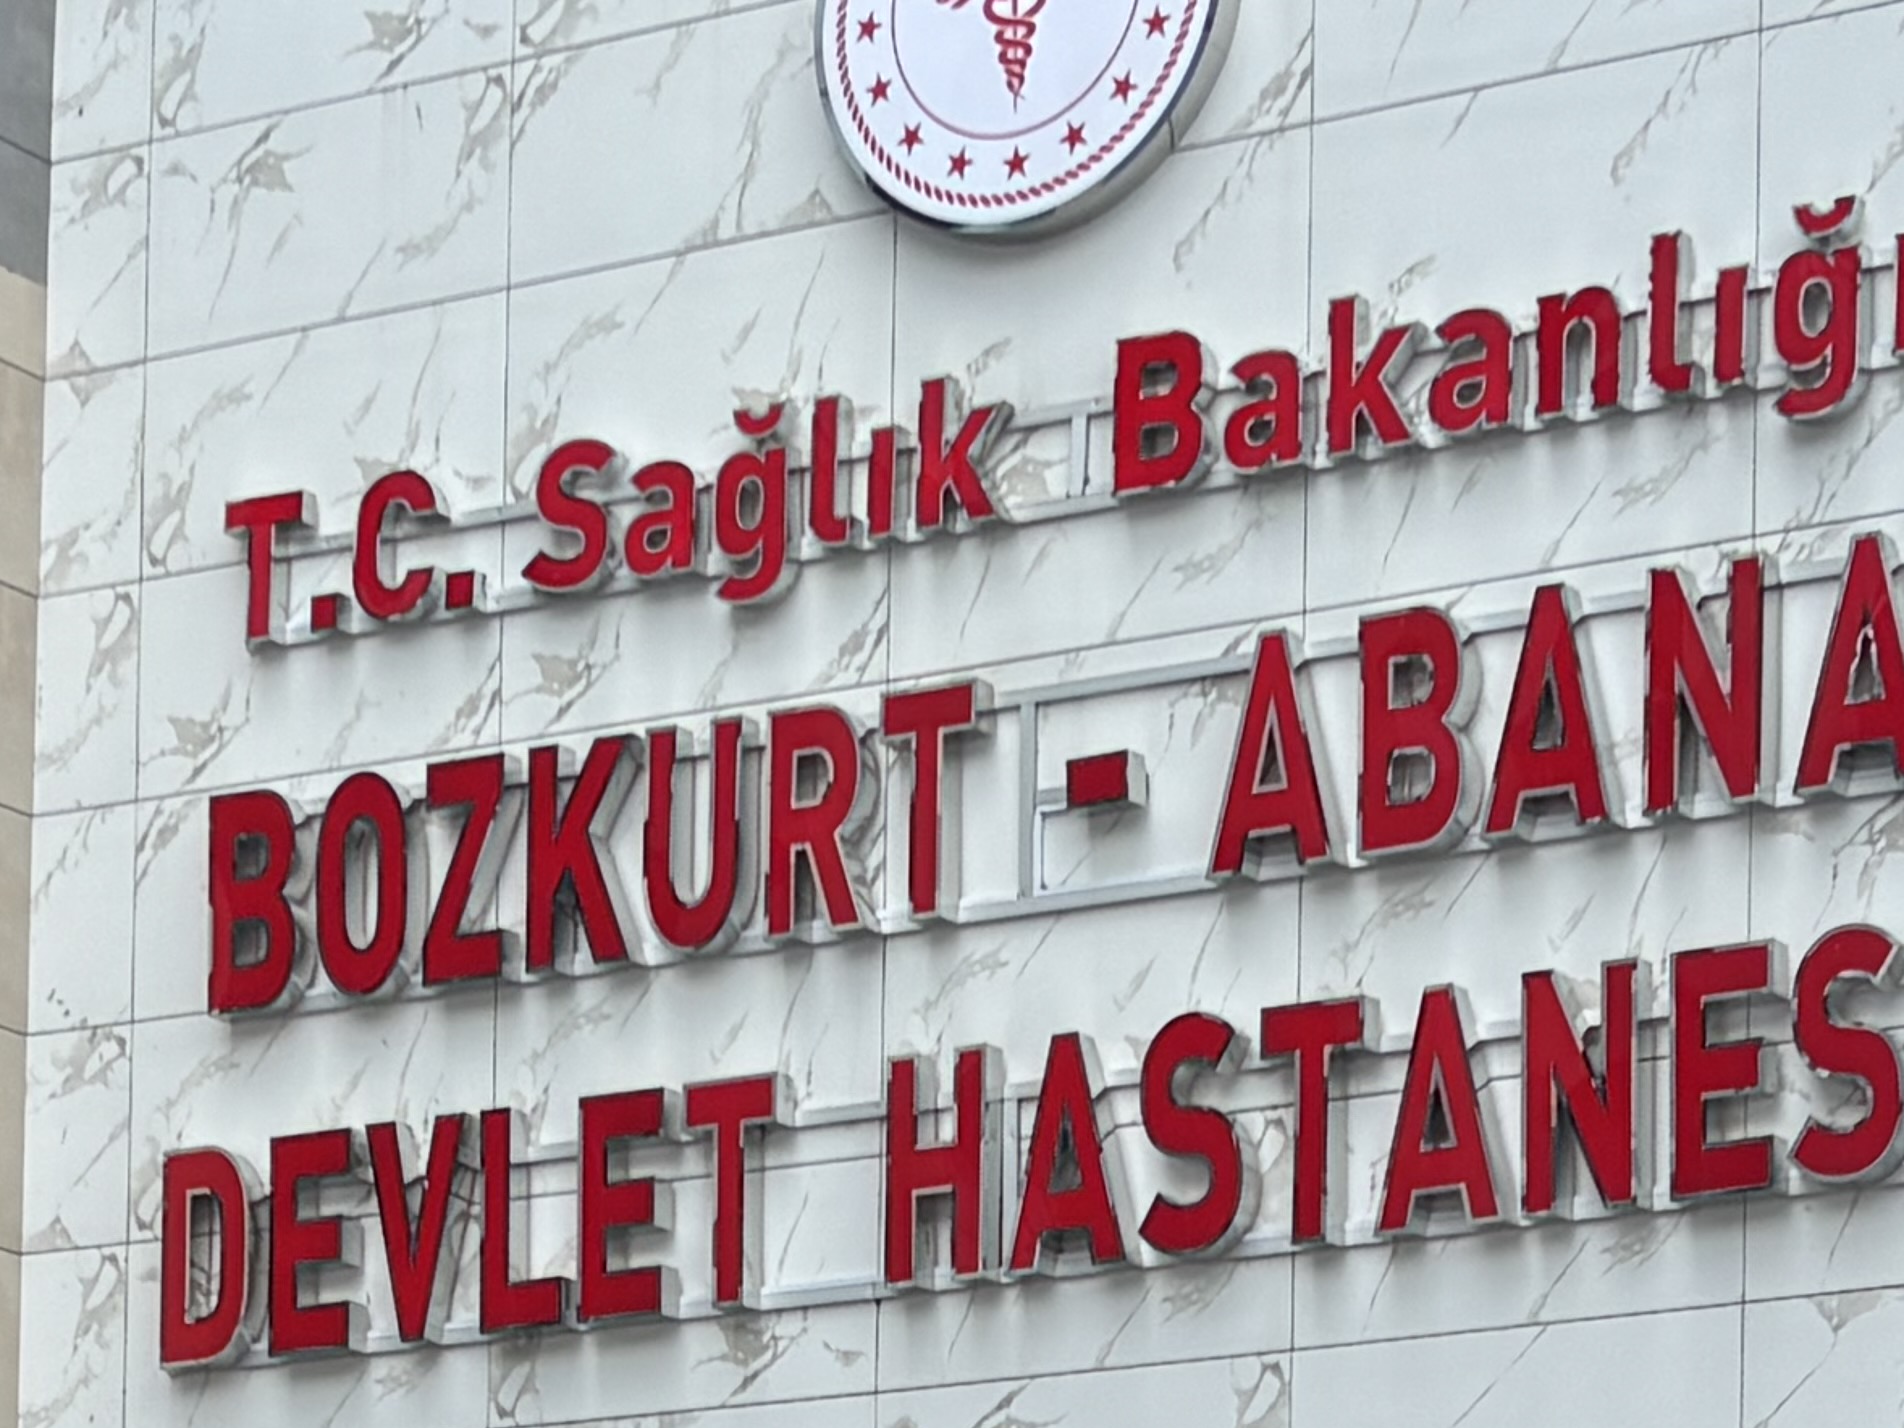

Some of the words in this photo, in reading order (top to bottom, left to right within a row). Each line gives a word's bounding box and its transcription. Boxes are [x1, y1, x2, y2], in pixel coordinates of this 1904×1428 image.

[224, 470, 476, 641] T.C.
[521, 380, 998, 604] Sağlık
[206, 683, 974, 1015] BOZKURT
[1066, 752, 1130, 808] -
[159, 1076, 776, 1366] DEVLET
